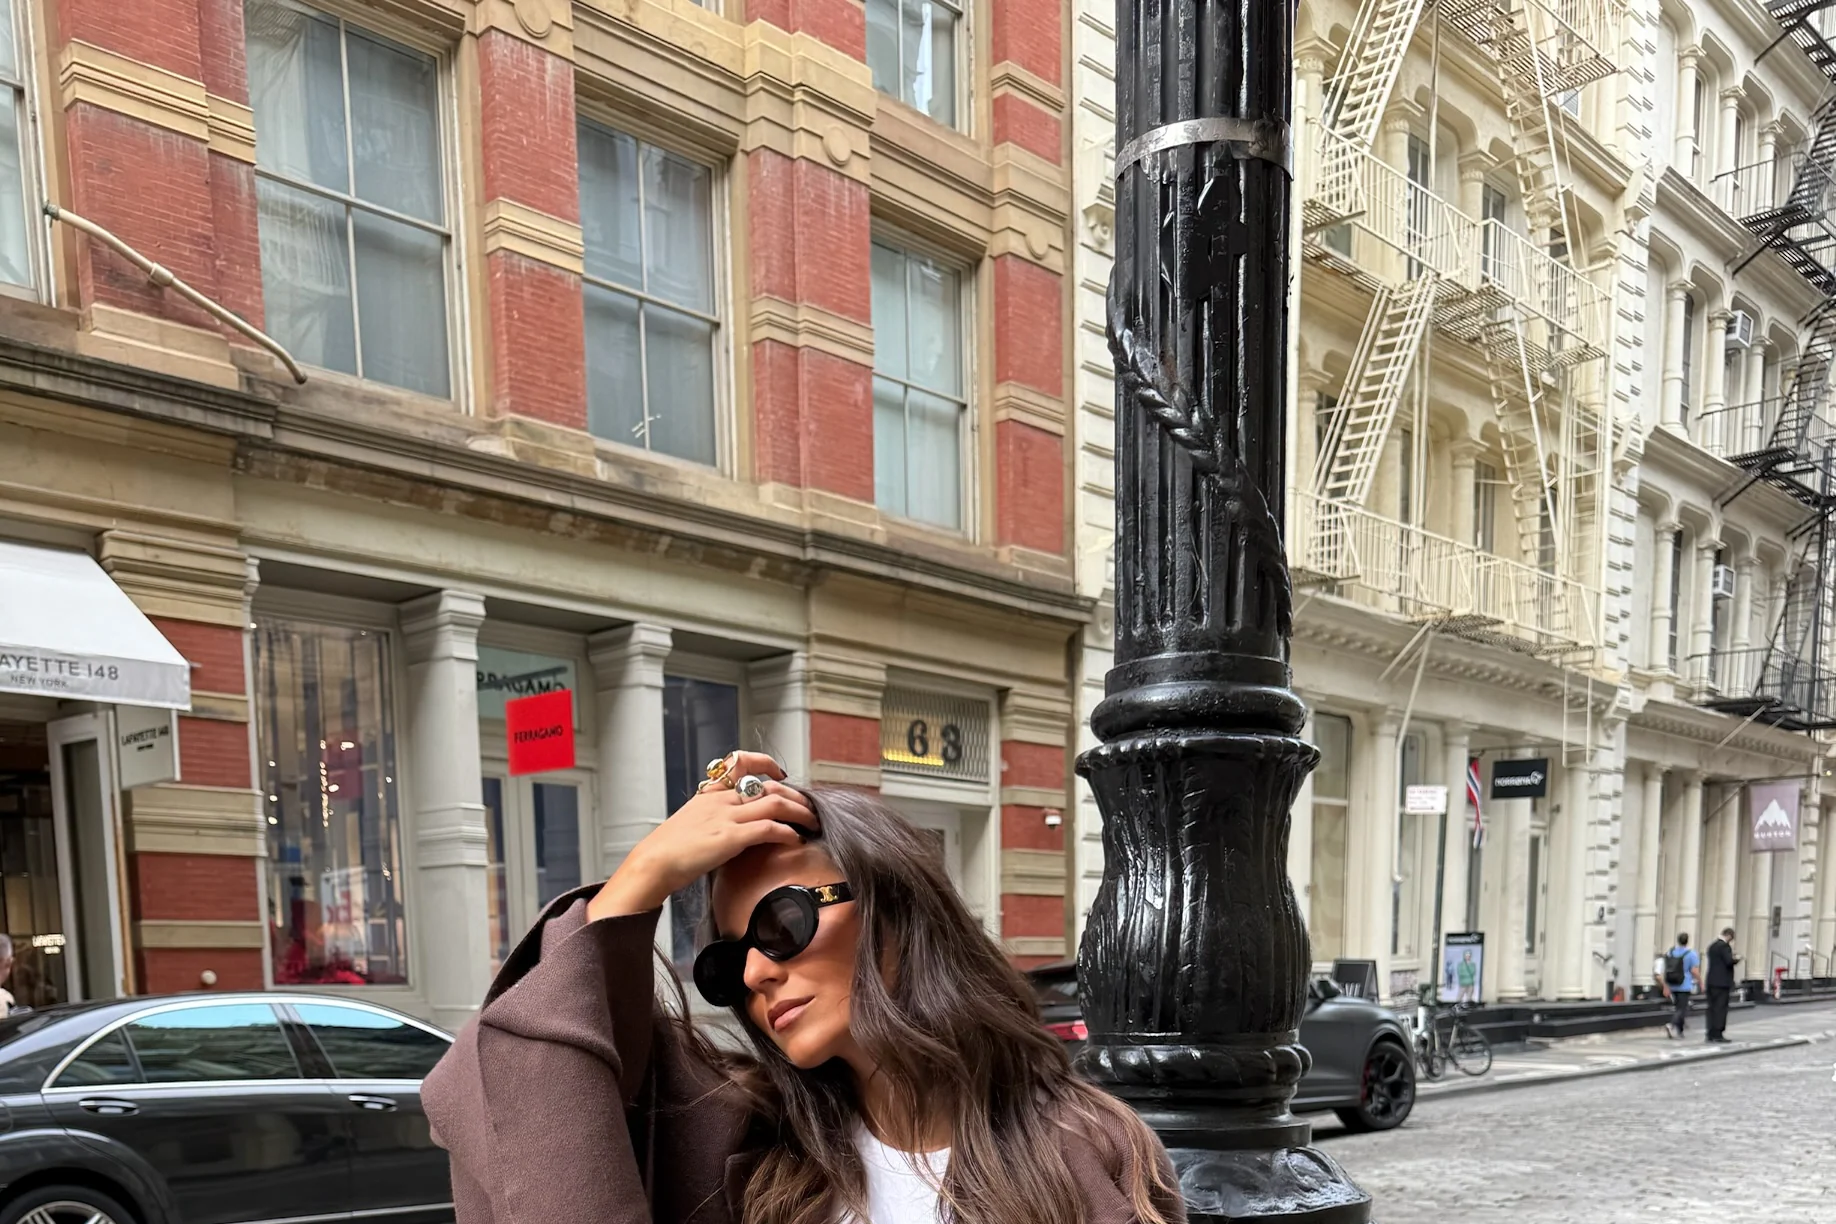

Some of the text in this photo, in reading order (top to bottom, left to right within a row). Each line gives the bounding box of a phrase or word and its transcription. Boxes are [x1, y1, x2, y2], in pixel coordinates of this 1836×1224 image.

[10, 673, 68, 689] NEW YORK
[87, 663, 119, 681] 148
[514, 725, 563, 744] FERRAGAMO
